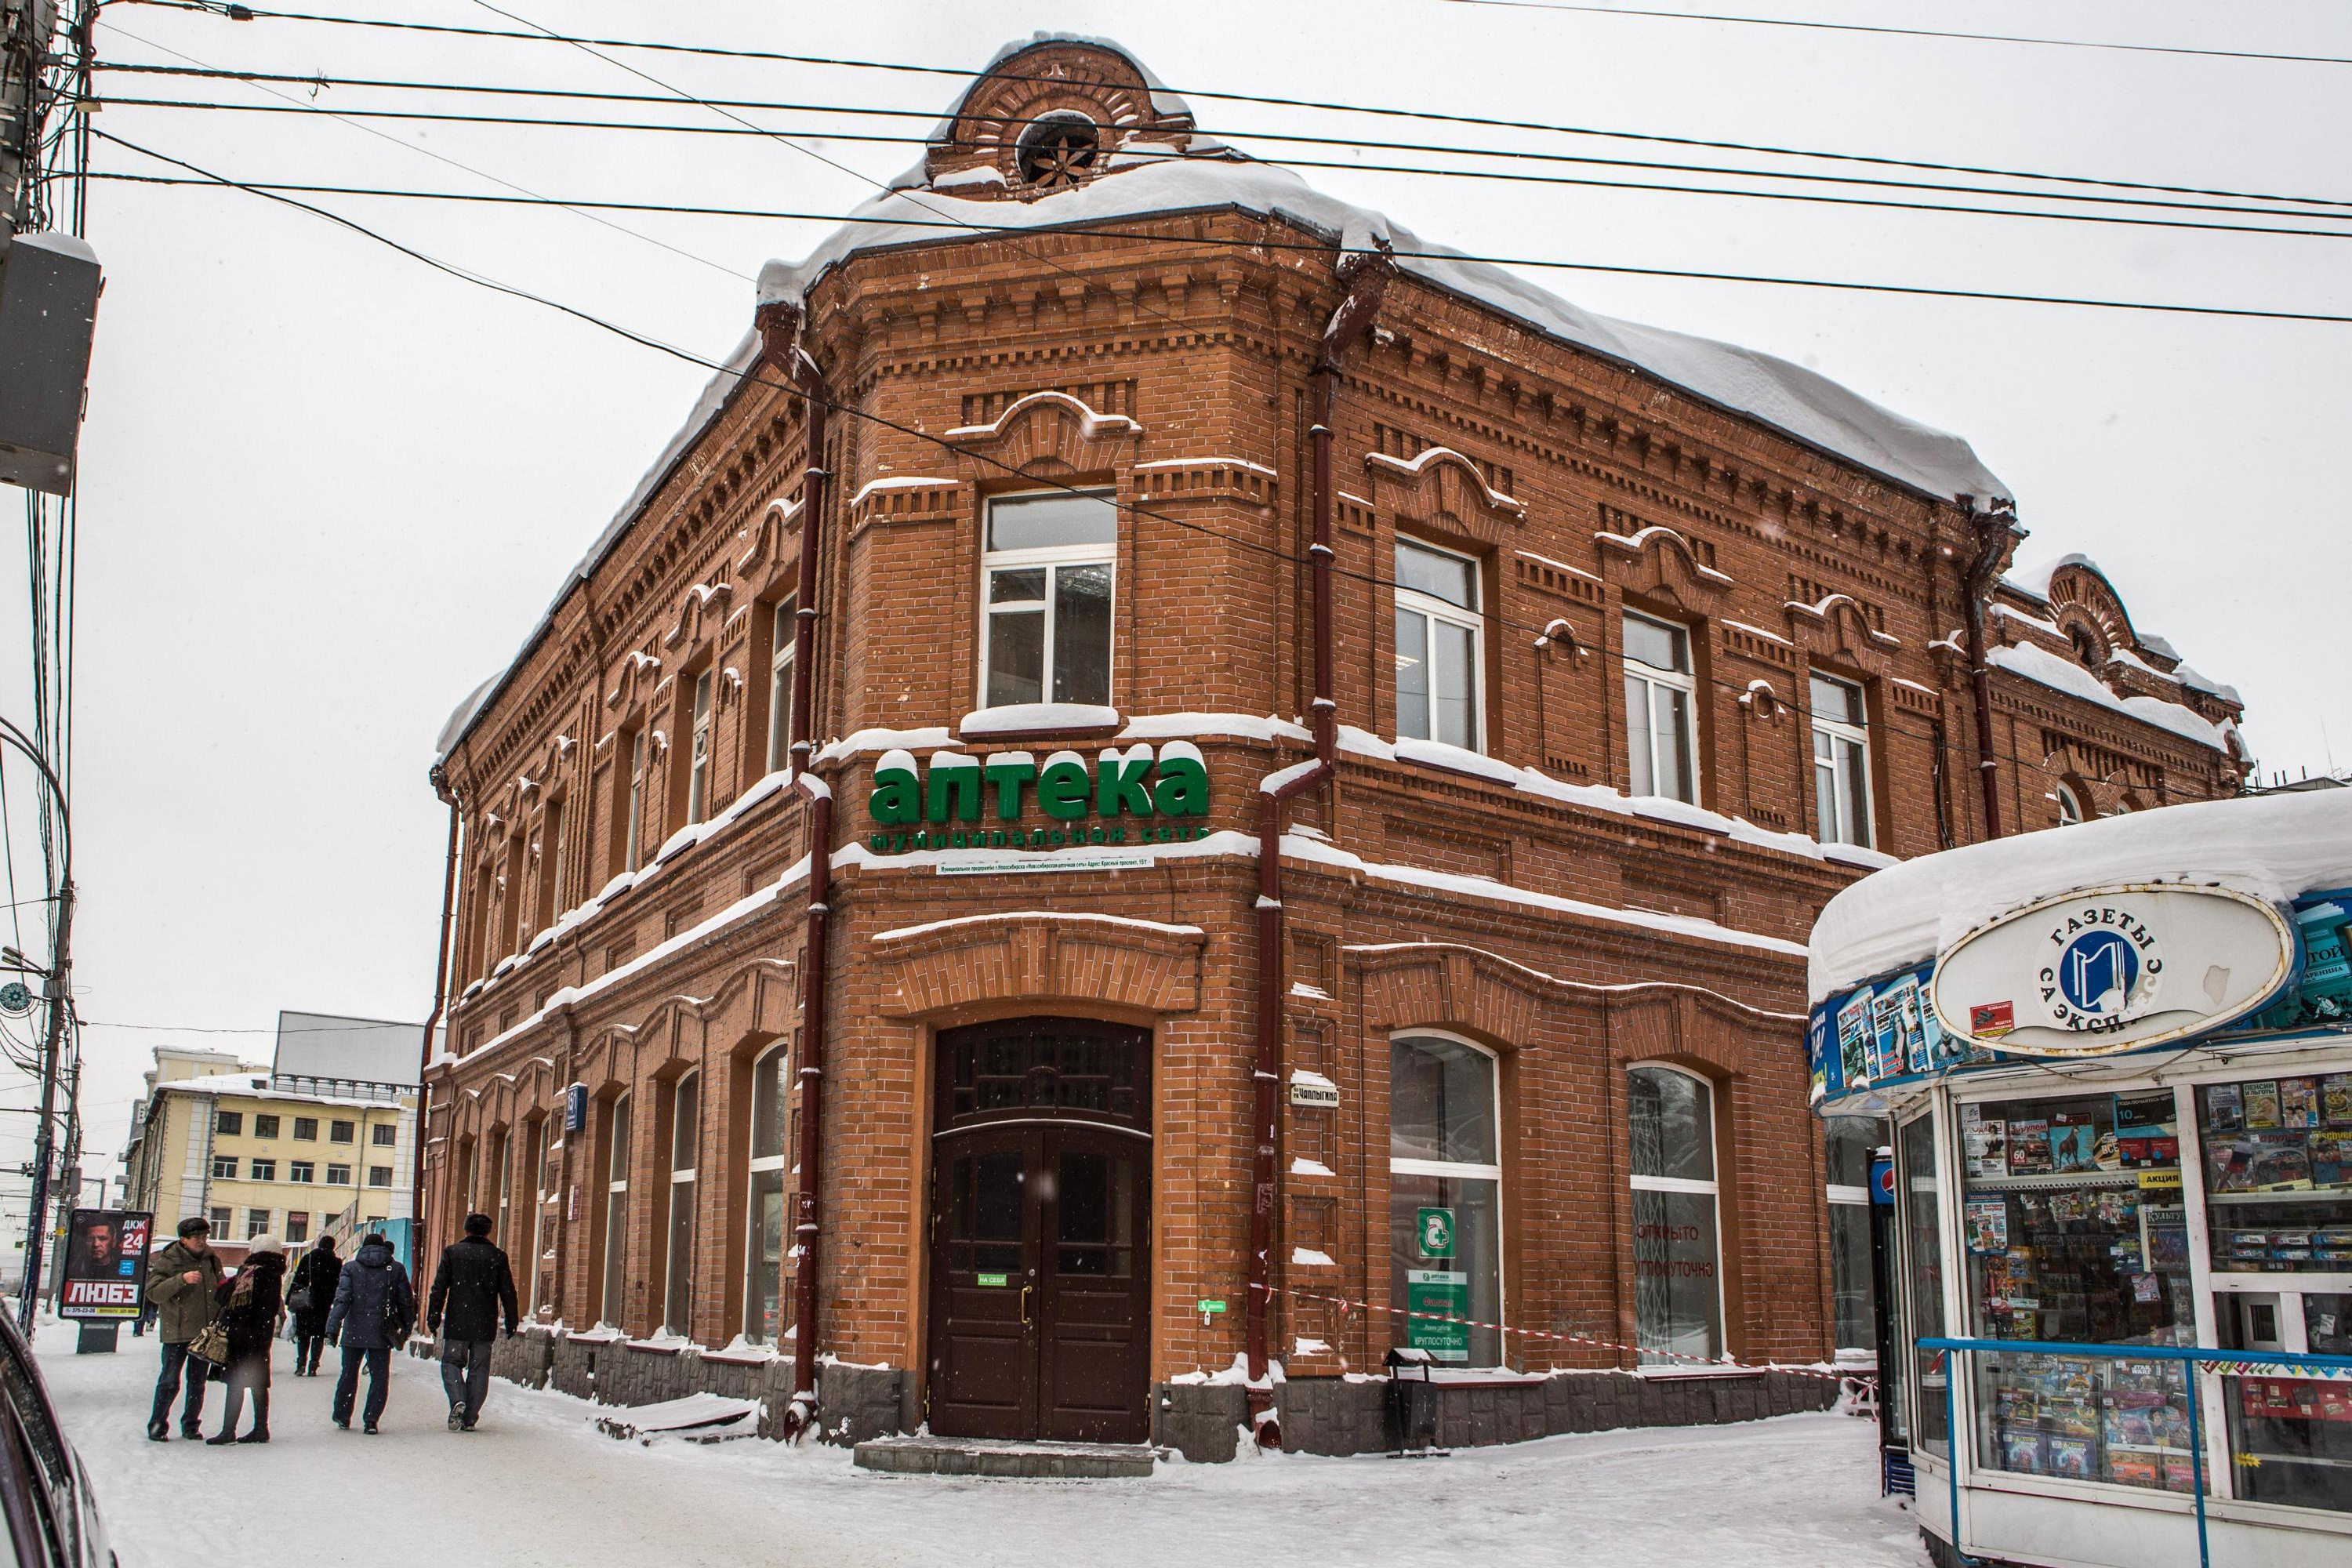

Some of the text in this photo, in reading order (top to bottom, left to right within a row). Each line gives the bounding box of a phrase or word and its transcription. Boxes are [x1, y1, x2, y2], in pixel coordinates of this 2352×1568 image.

[869, 743, 1210, 824] аптека
[870, 826, 1210, 853] муниципальная сеть
[2050, 908, 2155, 950] ГАЗЕТЫ
[1299, 1087, 1338, 1102] ЧАПЛЫГИНА
[2119, 1109, 2132, 1120] 10
[2013, 1149, 2025, 1160] 60
[2147, 1174, 2179, 1183] АКЦИЯ
[122, 1219, 146, 1230] ДКЖ
[1637, 1224, 1699, 1240] ОТКРЫТО
[123, 1232, 144, 1249] 24
[1423, 1297, 1454, 1308] Филиал
[1414, 1336, 1463, 1346] КРУГЛОСУТОЧНО
